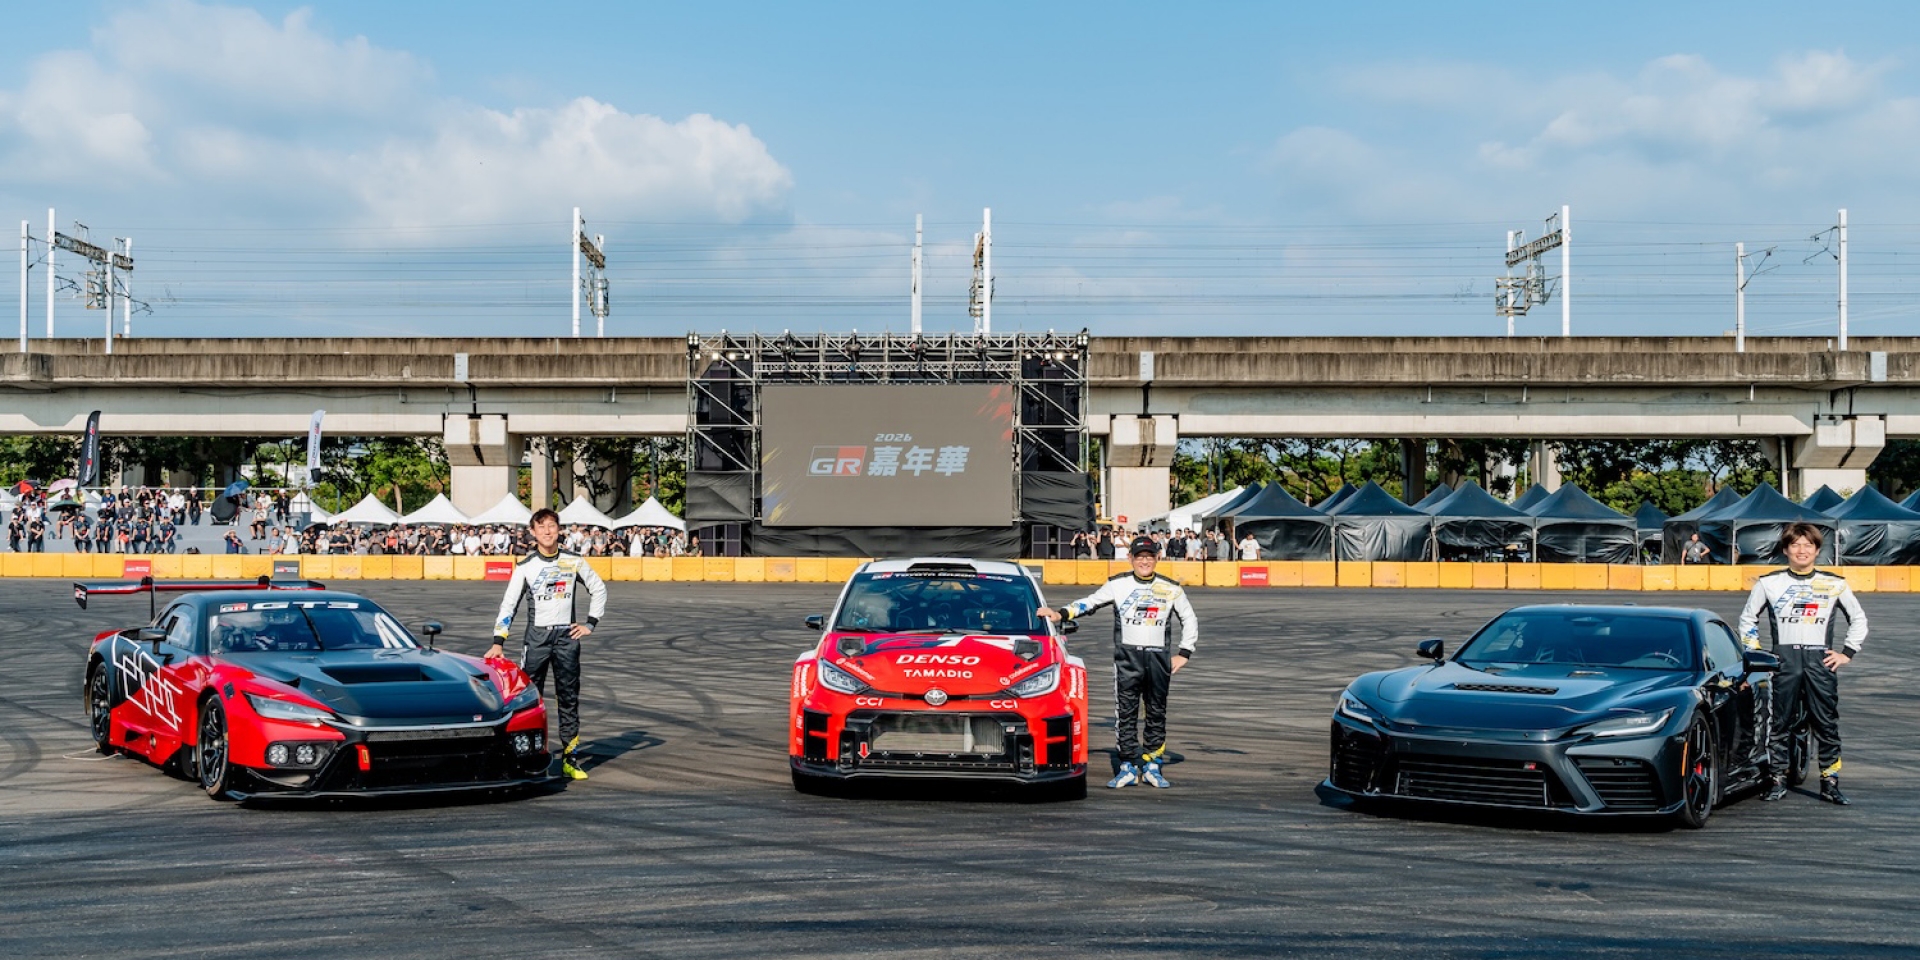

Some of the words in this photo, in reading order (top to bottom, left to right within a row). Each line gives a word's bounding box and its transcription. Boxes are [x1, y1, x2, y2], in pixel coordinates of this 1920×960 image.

[874, 433, 912, 442] 2026
[808, 455, 862, 475] GR
[867, 445, 970, 476] 嘉年華
[546, 583, 567, 593] GR
[252, 602, 360, 610] GT3
[1791, 606, 1819, 616] GR
[1135, 609, 1158, 618] GR
[896, 654, 981, 665] DENSO
[855, 697, 883, 706] CCI
[990, 699, 1019, 709] CCI
